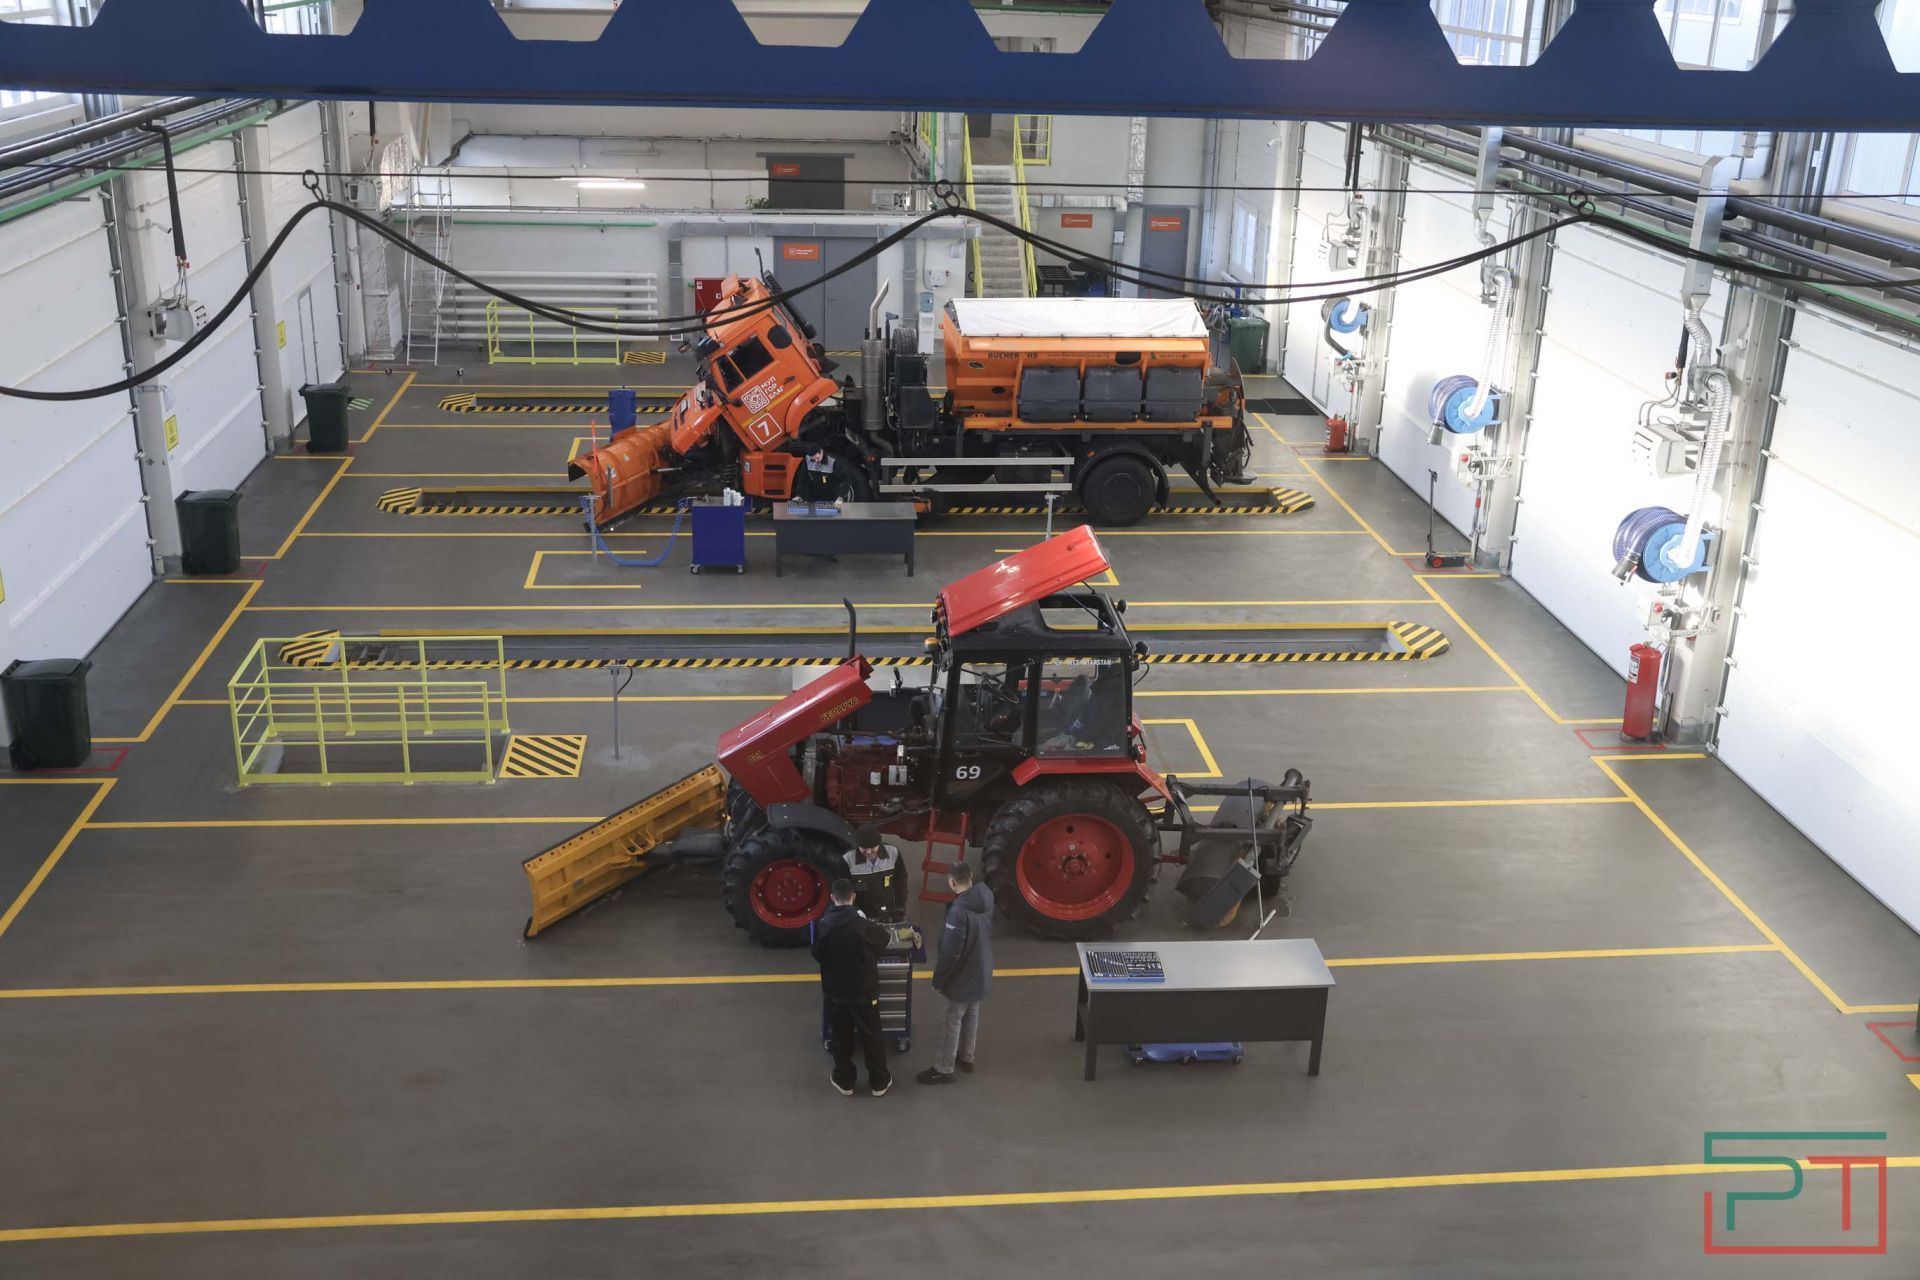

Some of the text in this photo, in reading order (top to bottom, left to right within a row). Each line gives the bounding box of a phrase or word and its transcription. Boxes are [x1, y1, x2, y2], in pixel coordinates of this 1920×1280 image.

[988, 352, 1019, 360] BUCHER
[760, 376, 776, 388] МУП
[765, 384, 778, 394] ГОР
[768, 385, 784, 400] БЛАГ
[757, 421, 770, 437] 7
[955, 765, 981, 780] 69
